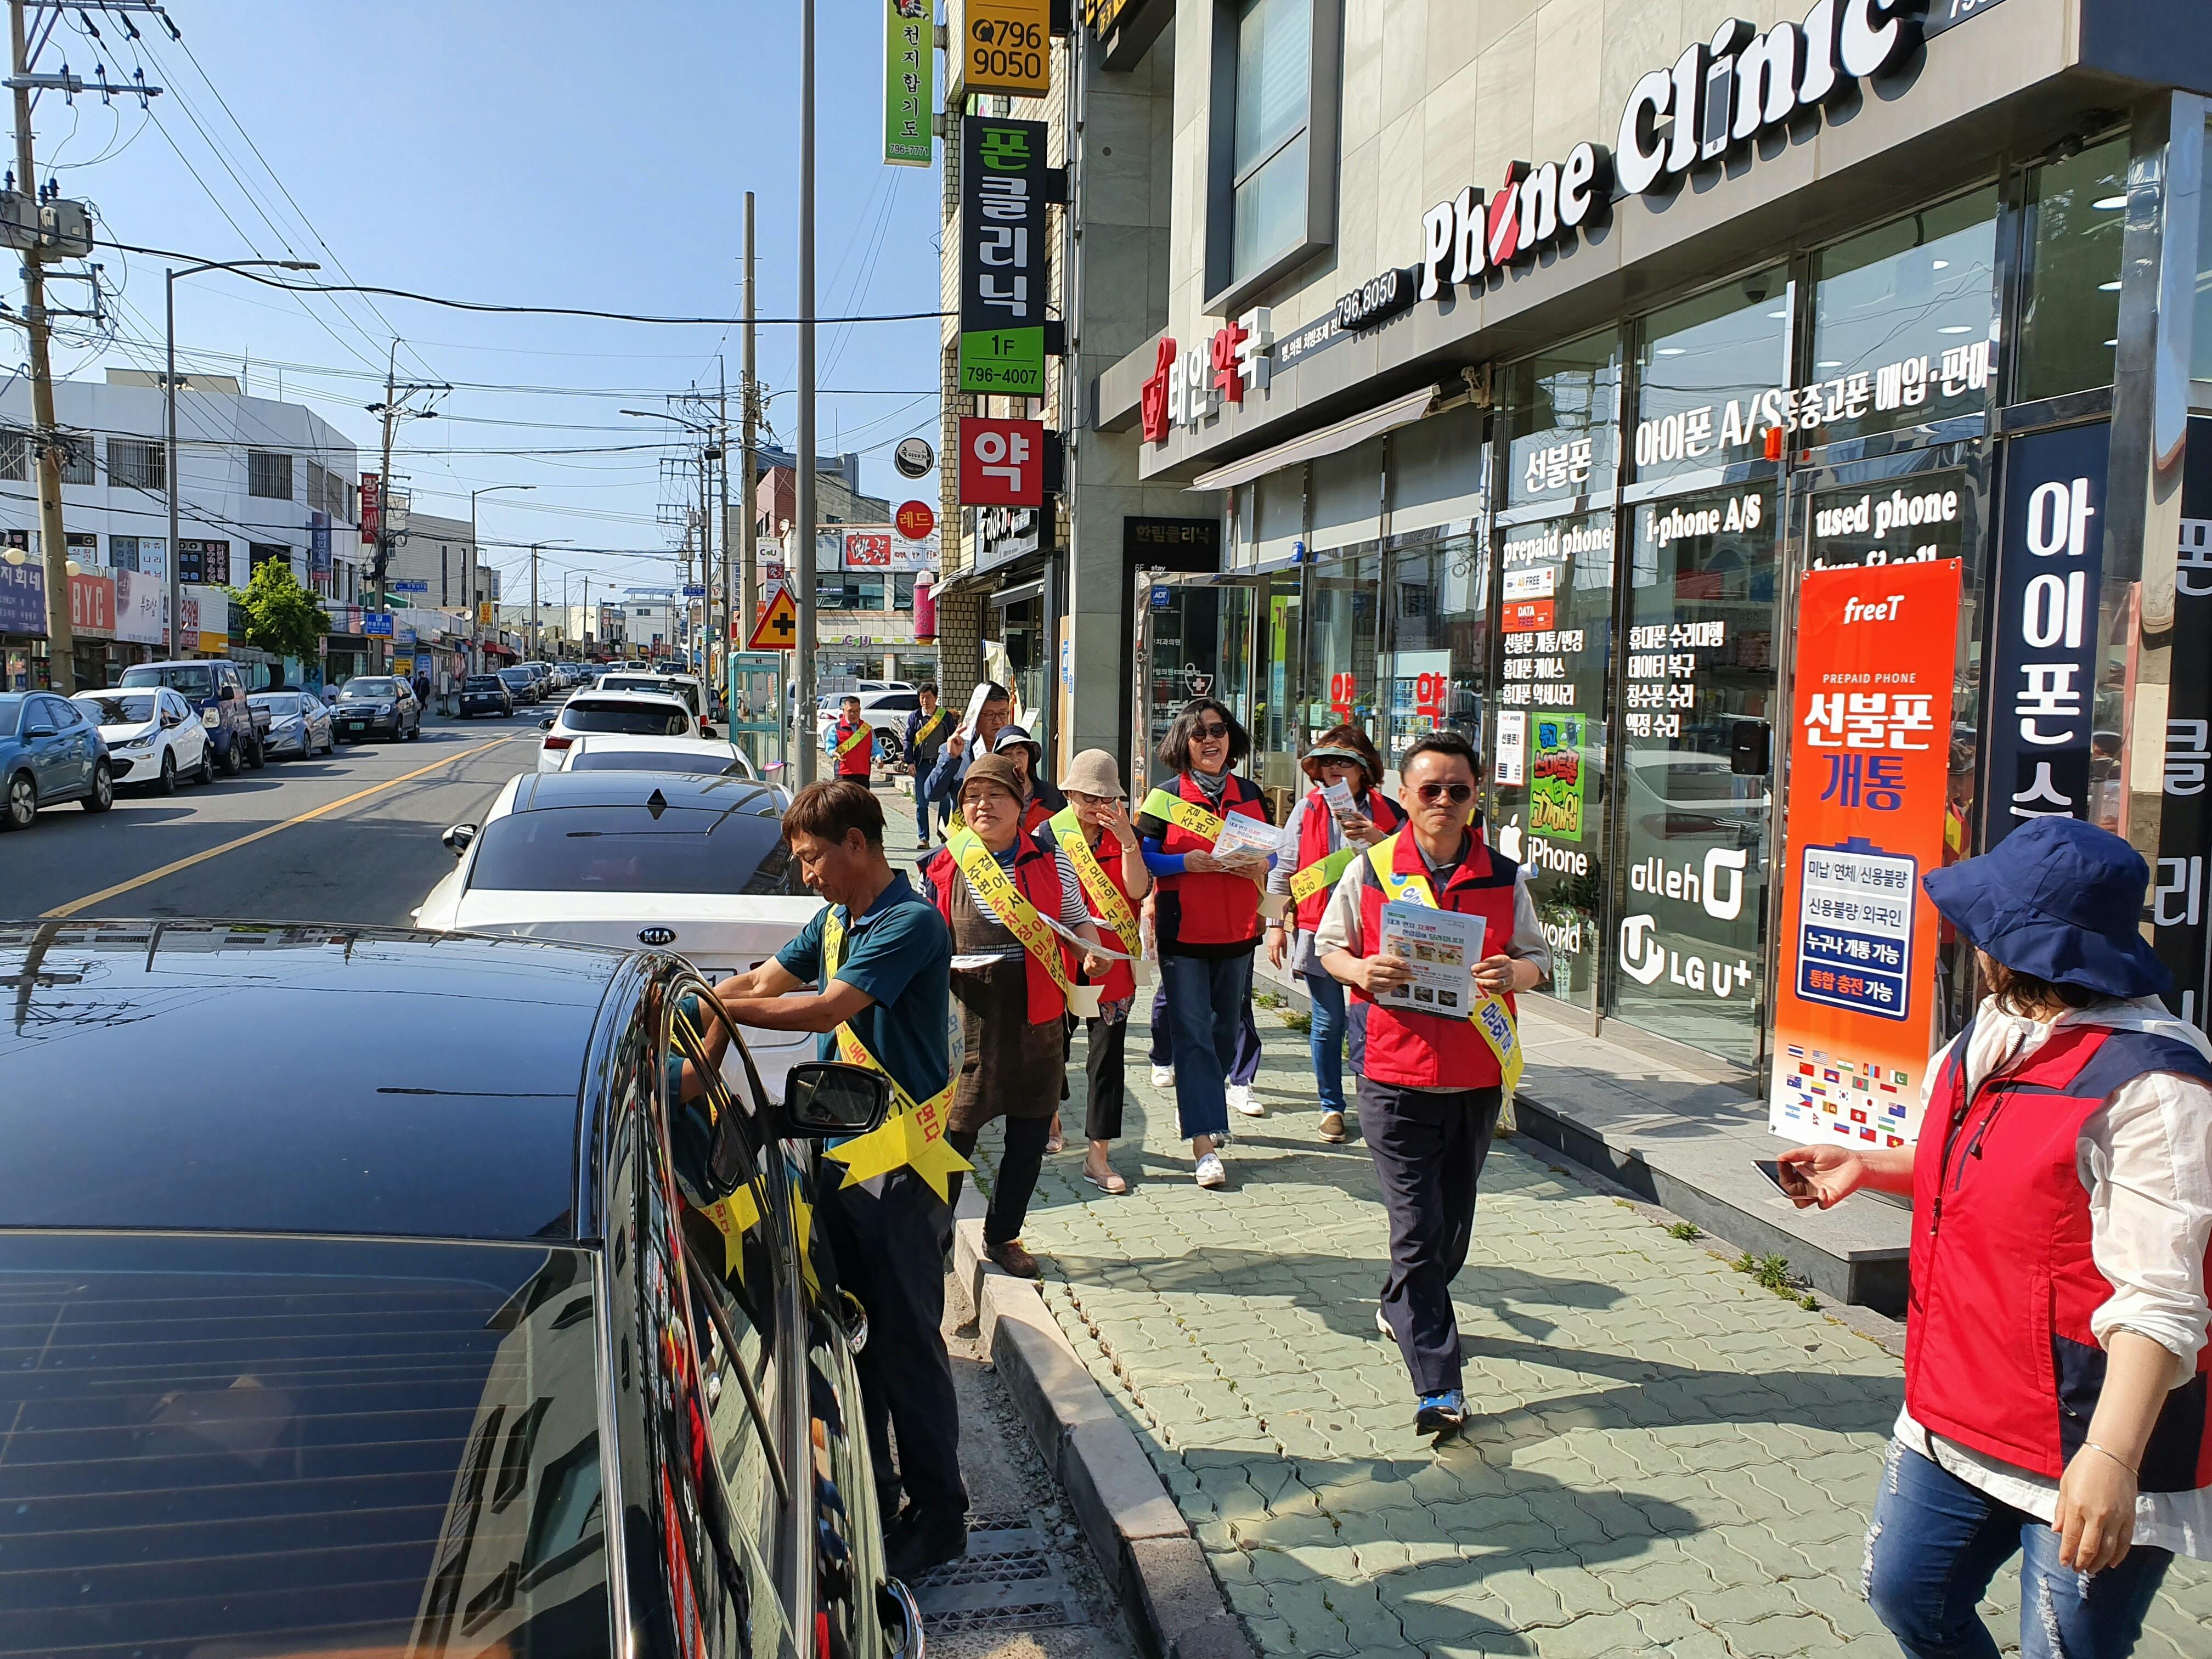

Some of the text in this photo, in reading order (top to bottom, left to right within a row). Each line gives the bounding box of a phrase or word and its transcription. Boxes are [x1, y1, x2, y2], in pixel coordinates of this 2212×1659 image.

[994, 20, 1041, 49] 796
[973, 48, 1041, 79] 9050
[900, 25, 921, 139] 천지합기도
[889, 143, 929, 157] 796-7771
[978, 127, 1031, 317] 폰클리닉
[1336, 271, 1397, 328] 796.8050
[991, 334, 1015, 356] 1F
[1304, 321, 1329, 350] 처방조제
[966, 366, 1038, 385] 796-4007
[1168, 306, 1271, 426] 태안약국
[1635, 388, 1782, 468] 아이폰 A/S
[901, 445, 926, 459] 죽이야기
[974, 431, 1030, 492] 약
[1523, 437, 1592, 494] 선불폰
[899, 512, 932, 529] 레드
[1645, 494, 1763, 548] i-phone A/S
[1815, 487, 1957, 539] used phone
[1136, 524, 1209, 544] 한림클리닉
[1503, 524, 1611, 569] prepaid phone
[1154, 591, 1167, 599] ADT
[1526, 575, 1540, 586] FREE
[72, 582, 104, 627] BYC
[1517, 605, 1535, 617] DATA
[1843, 595, 1905, 625] freeT
[1518, 617, 1534, 627] FREE
[1629, 621, 1725, 651] 휴대폰 수리대행
[844, 634, 870, 647] CU
[1503, 629, 1584, 654] 선불폰 개통/변경
[1503, 656, 1565, 679] 휴대폰 케이스
[1628, 653, 1695, 679] 데이터 복구
[1822, 672, 1917, 685] PREPAID PHONE
[1331, 672, 1356, 725] 약
[1417, 671, 1444, 730] 약
[1502, 684, 1575, 706] 휴대폰 악세사리
[1626, 682, 1694, 709] 침수폰 수리
[1626, 713, 1680, 738] 액정 수리
[1803, 692, 1934, 751] 선불폰
[1820, 753, 1907, 811] 개통
[1531, 789, 1581, 832] 고가매입
[1527, 836, 1588, 877] iPhone
[978, 854, 1025, 910] 걸어서
[1631, 856, 1700, 903] olleh
[1808, 860, 1909, 889] 미납/연체/신용불량
[967, 865, 993, 896] 주변
[991, 896, 1033, 941] 주차장
[1808, 896, 1903, 928] 신용불량/외국인
[644, 930, 672, 942] KIA
[1806, 932, 1900, 966] 누구나 개통 가능
[1670, 951, 1752, 997] LG U+
[1808, 968, 1894, 1003] 통합 충전 가능
